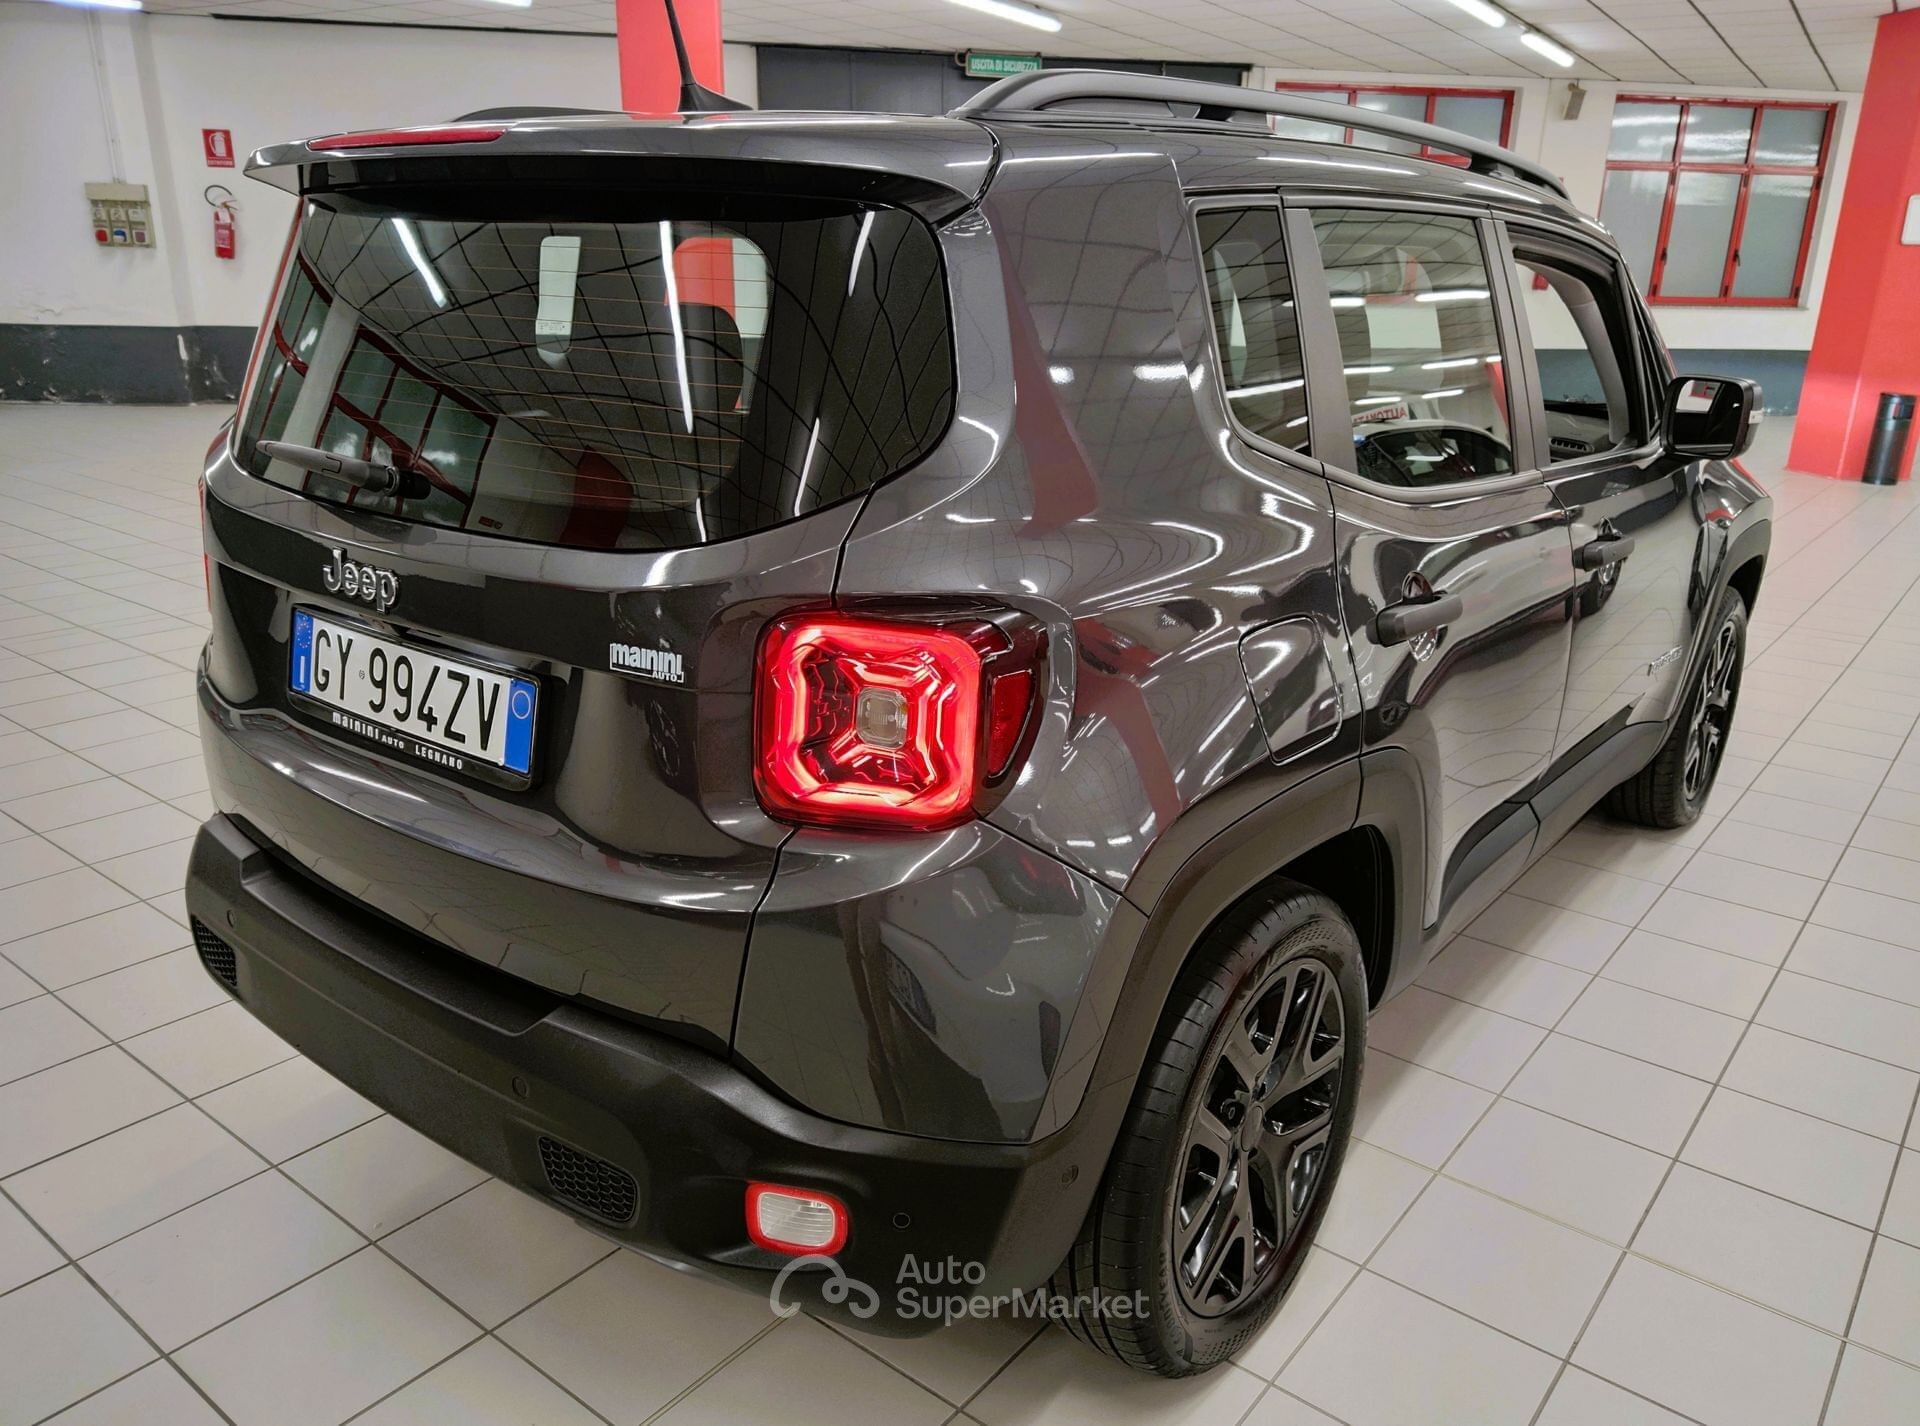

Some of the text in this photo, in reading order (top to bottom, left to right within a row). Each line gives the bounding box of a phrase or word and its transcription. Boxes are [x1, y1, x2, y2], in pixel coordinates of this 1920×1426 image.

[971, 58, 993, 70] USCITA
[995, 60, 1002, 71] DI
[322, 547, 399, 614] Jeep
[314, 628, 353, 701] GY
[368, 647, 501, 752] 994ZV
[652, 671, 678, 683] AUTO
[381, 734, 405, 750] AUTO
[415, 743, 463, 771] LEGNANO
